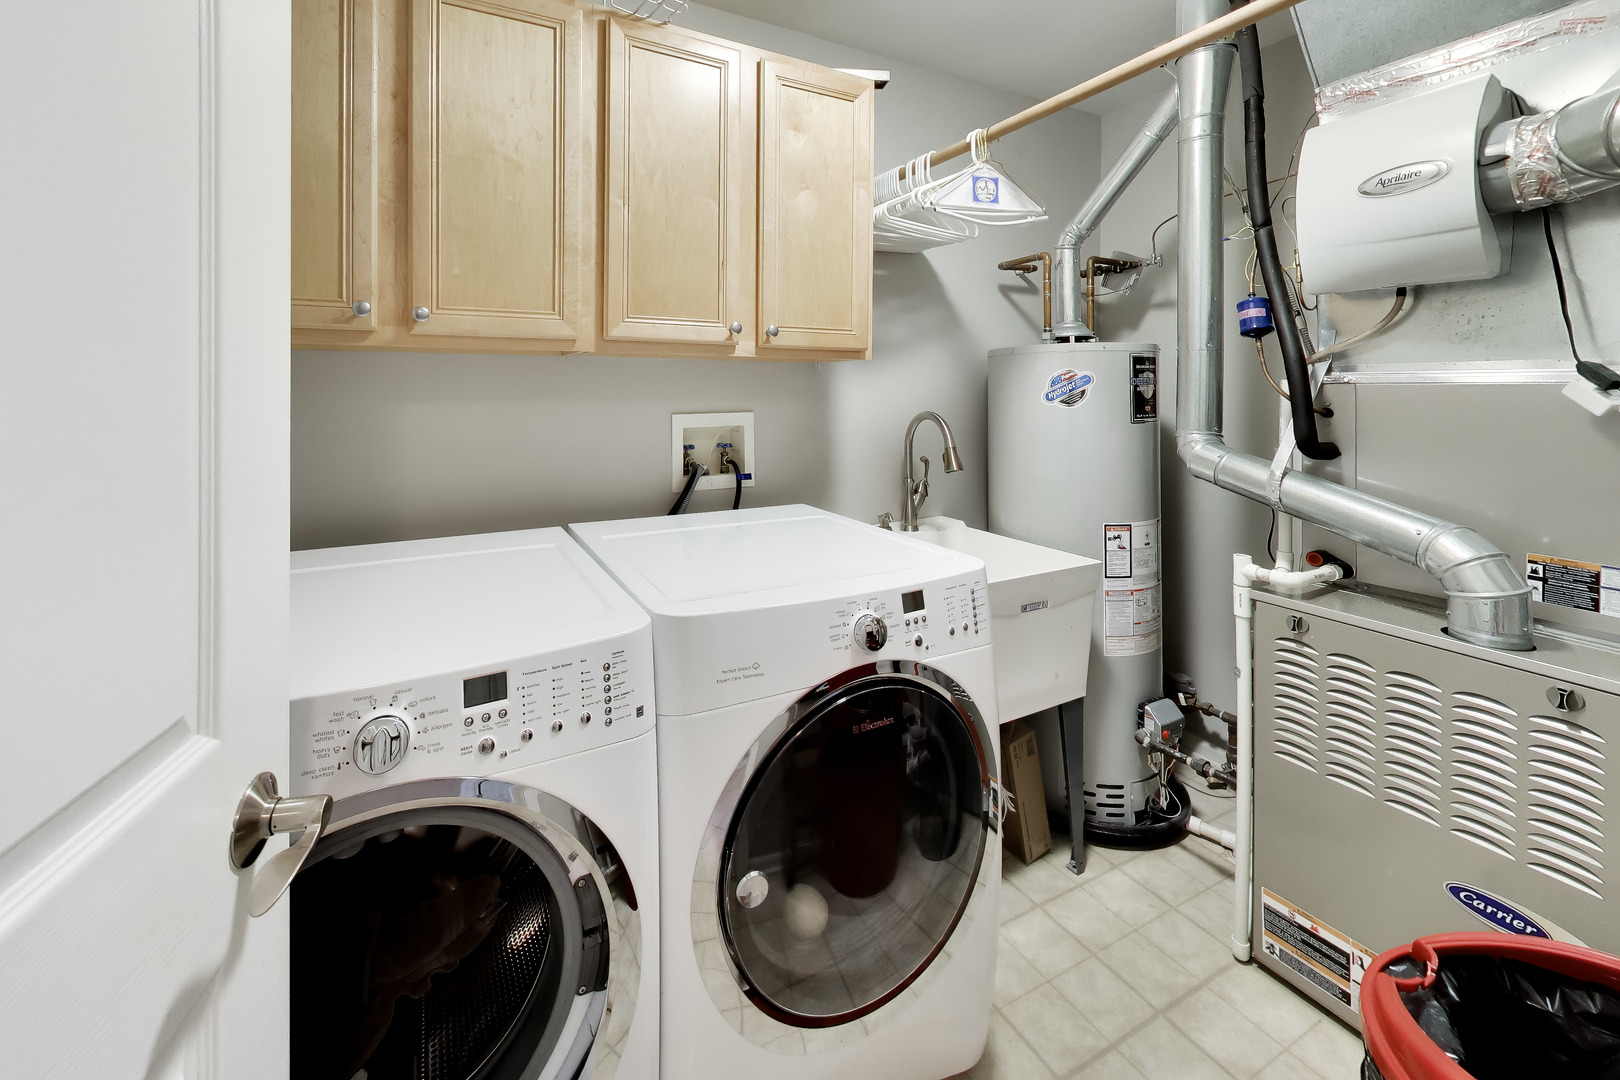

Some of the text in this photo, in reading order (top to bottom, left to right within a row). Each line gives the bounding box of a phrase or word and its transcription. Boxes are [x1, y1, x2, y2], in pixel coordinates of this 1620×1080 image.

[1375, 169, 1422, 189] Aprilaire
[1048, 381, 1076, 399] Hydrojet
[394, 687, 413, 695] casual
[353, 694, 374, 702] normal
[427, 708, 449, 716] delicate
[312, 730, 335, 738] whitest
[312, 747, 331, 755] heavy
[301, 765, 335, 778] deep clean
[1459, 891, 1538, 934] Carrier
